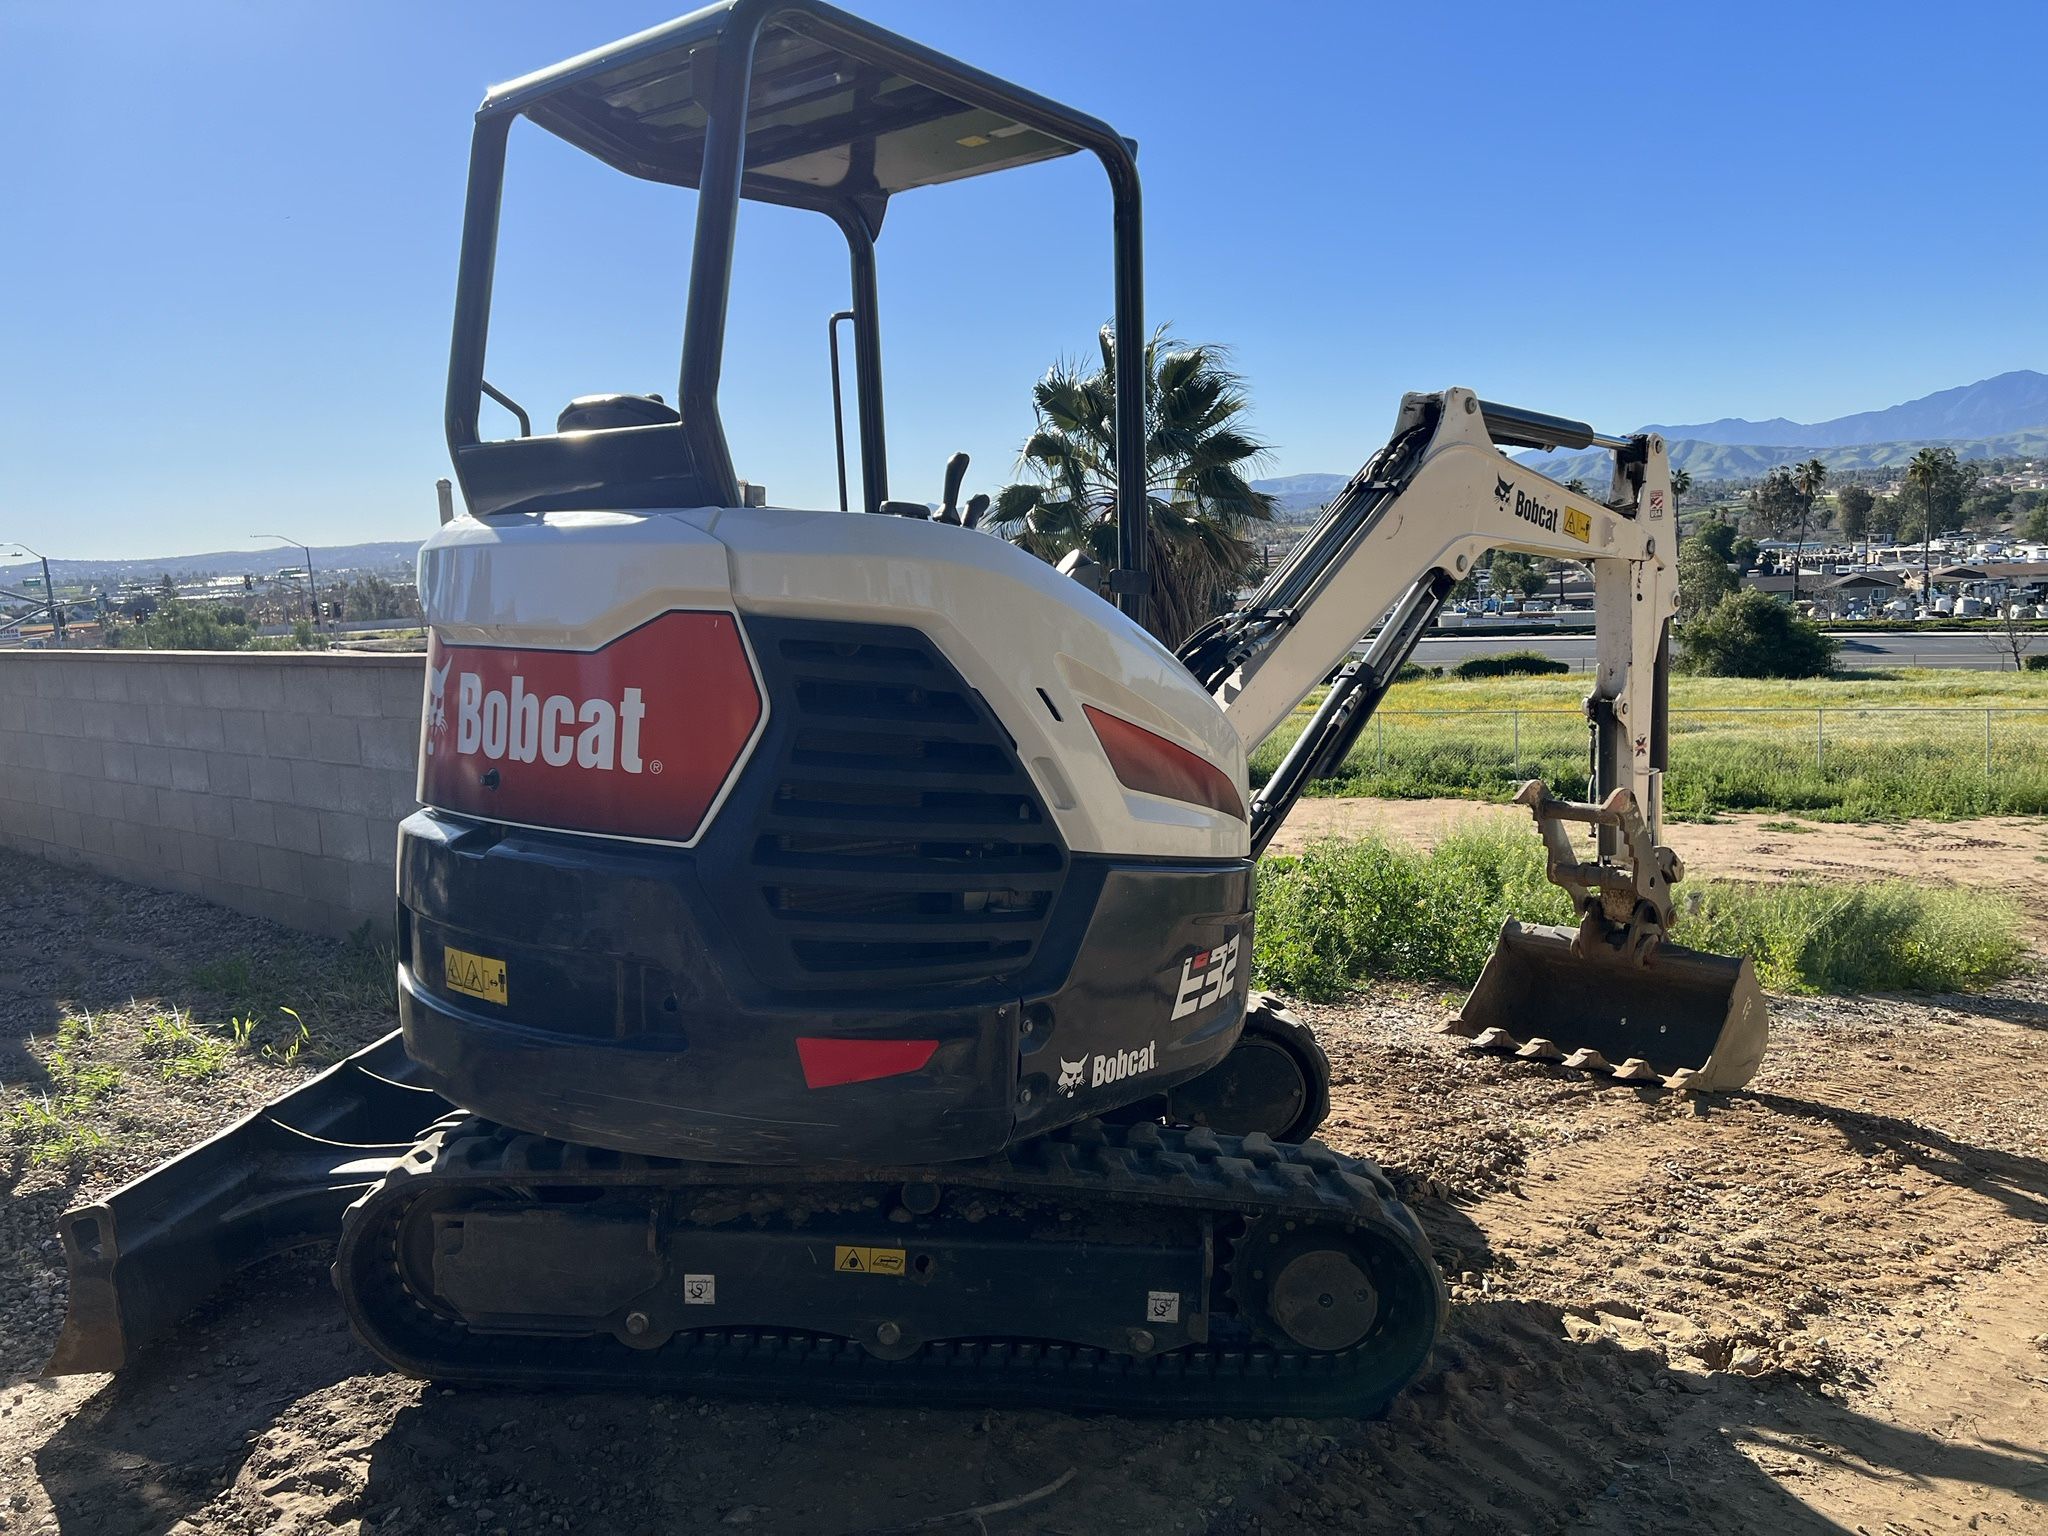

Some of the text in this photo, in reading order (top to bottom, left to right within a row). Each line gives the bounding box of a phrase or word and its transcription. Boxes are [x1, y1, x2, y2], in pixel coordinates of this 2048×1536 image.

[1515, 490, 1558, 533] Bobcat
[457, 672, 645, 773] Bobcat
[1170, 933, 1240, 1021] E32
[1091, 1040, 1156, 1088] Bobcat
